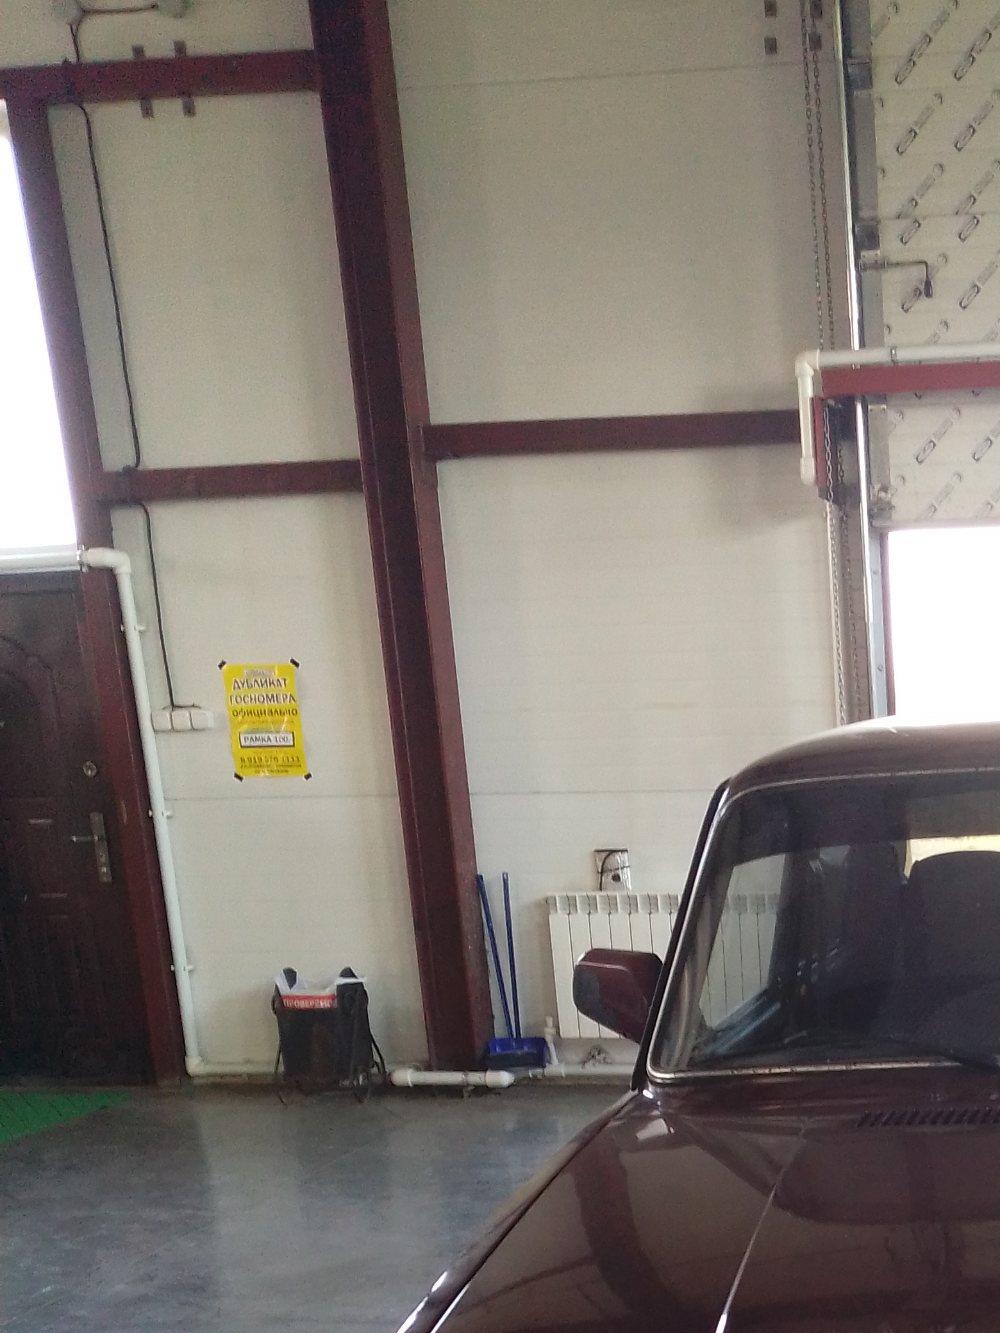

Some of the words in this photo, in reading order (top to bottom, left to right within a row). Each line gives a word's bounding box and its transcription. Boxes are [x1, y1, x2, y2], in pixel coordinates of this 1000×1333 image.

[233, 678, 287, 690] ДУБЛИКАТ
[230, 693, 296, 705] ГОСНОМЕРА
[243, 735, 272, 744] РАМКА
